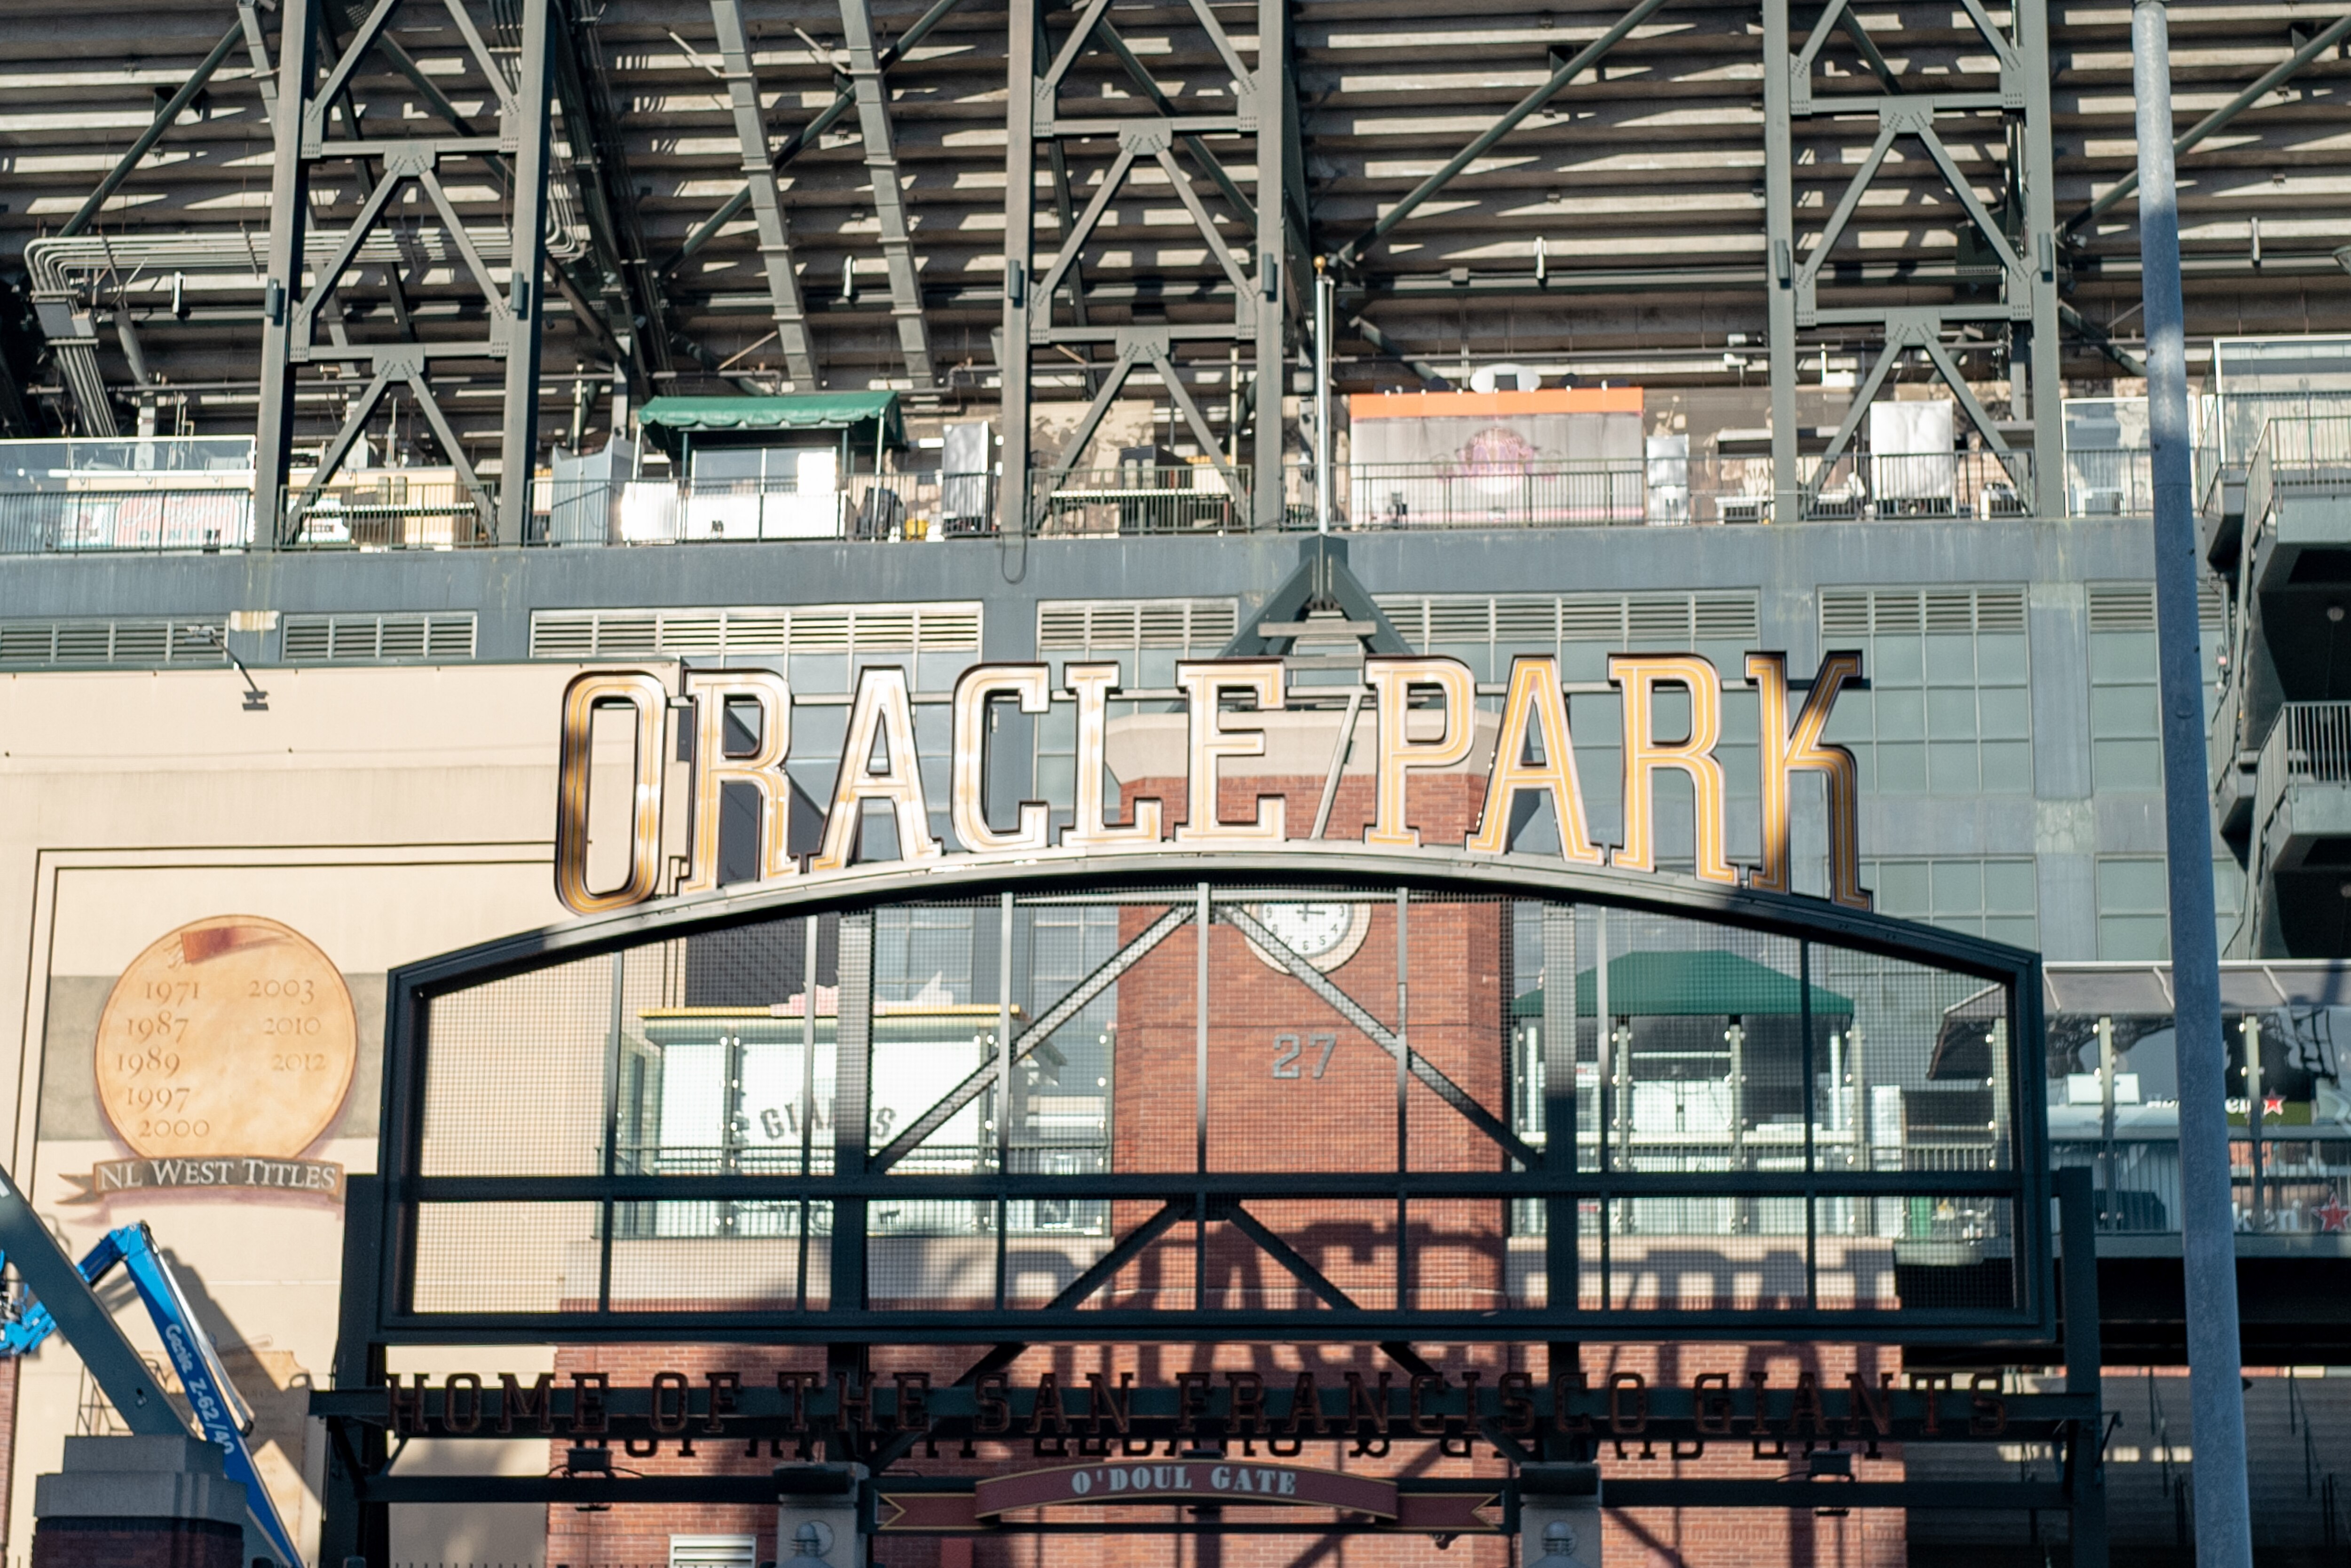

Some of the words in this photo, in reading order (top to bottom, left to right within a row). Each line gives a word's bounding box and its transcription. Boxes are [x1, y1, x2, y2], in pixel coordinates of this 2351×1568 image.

[554, 657, 1286, 917] ORACLE
[1364, 651, 1874, 911] PARK
[145, 980, 199, 1007] 1971
[249, 979, 315, 1005] 2003
[127, 1009, 189, 1043] 1987
[264, 1016, 322, 1036] 2010
[118, 1045, 181, 1078] 1989
[272, 1053, 327, 1072] 2012
[1272, 1033, 1337, 1079] 27
[127, 1085, 190, 1112] 1997
[139, 1119, 210, 1138] 2000
[99, 1165, 142, 1190] NL
[164, 1324, 193, 1374] Genie
[386, 1372, 609, 1434] HOME
[650, 1372, 742, 1434] OF
[777, 1372, 933, 1434] THE
[972, 1372, 1134, 1434] SAN
[1176, 1372, 1646, 1434] FRANCISCO
[1693, 1372, 2007, 1436] GIANTS
[1071, 1466, 1191, 1495] O'DOUL
[1211, 1466, 1296, 1496] GATE
